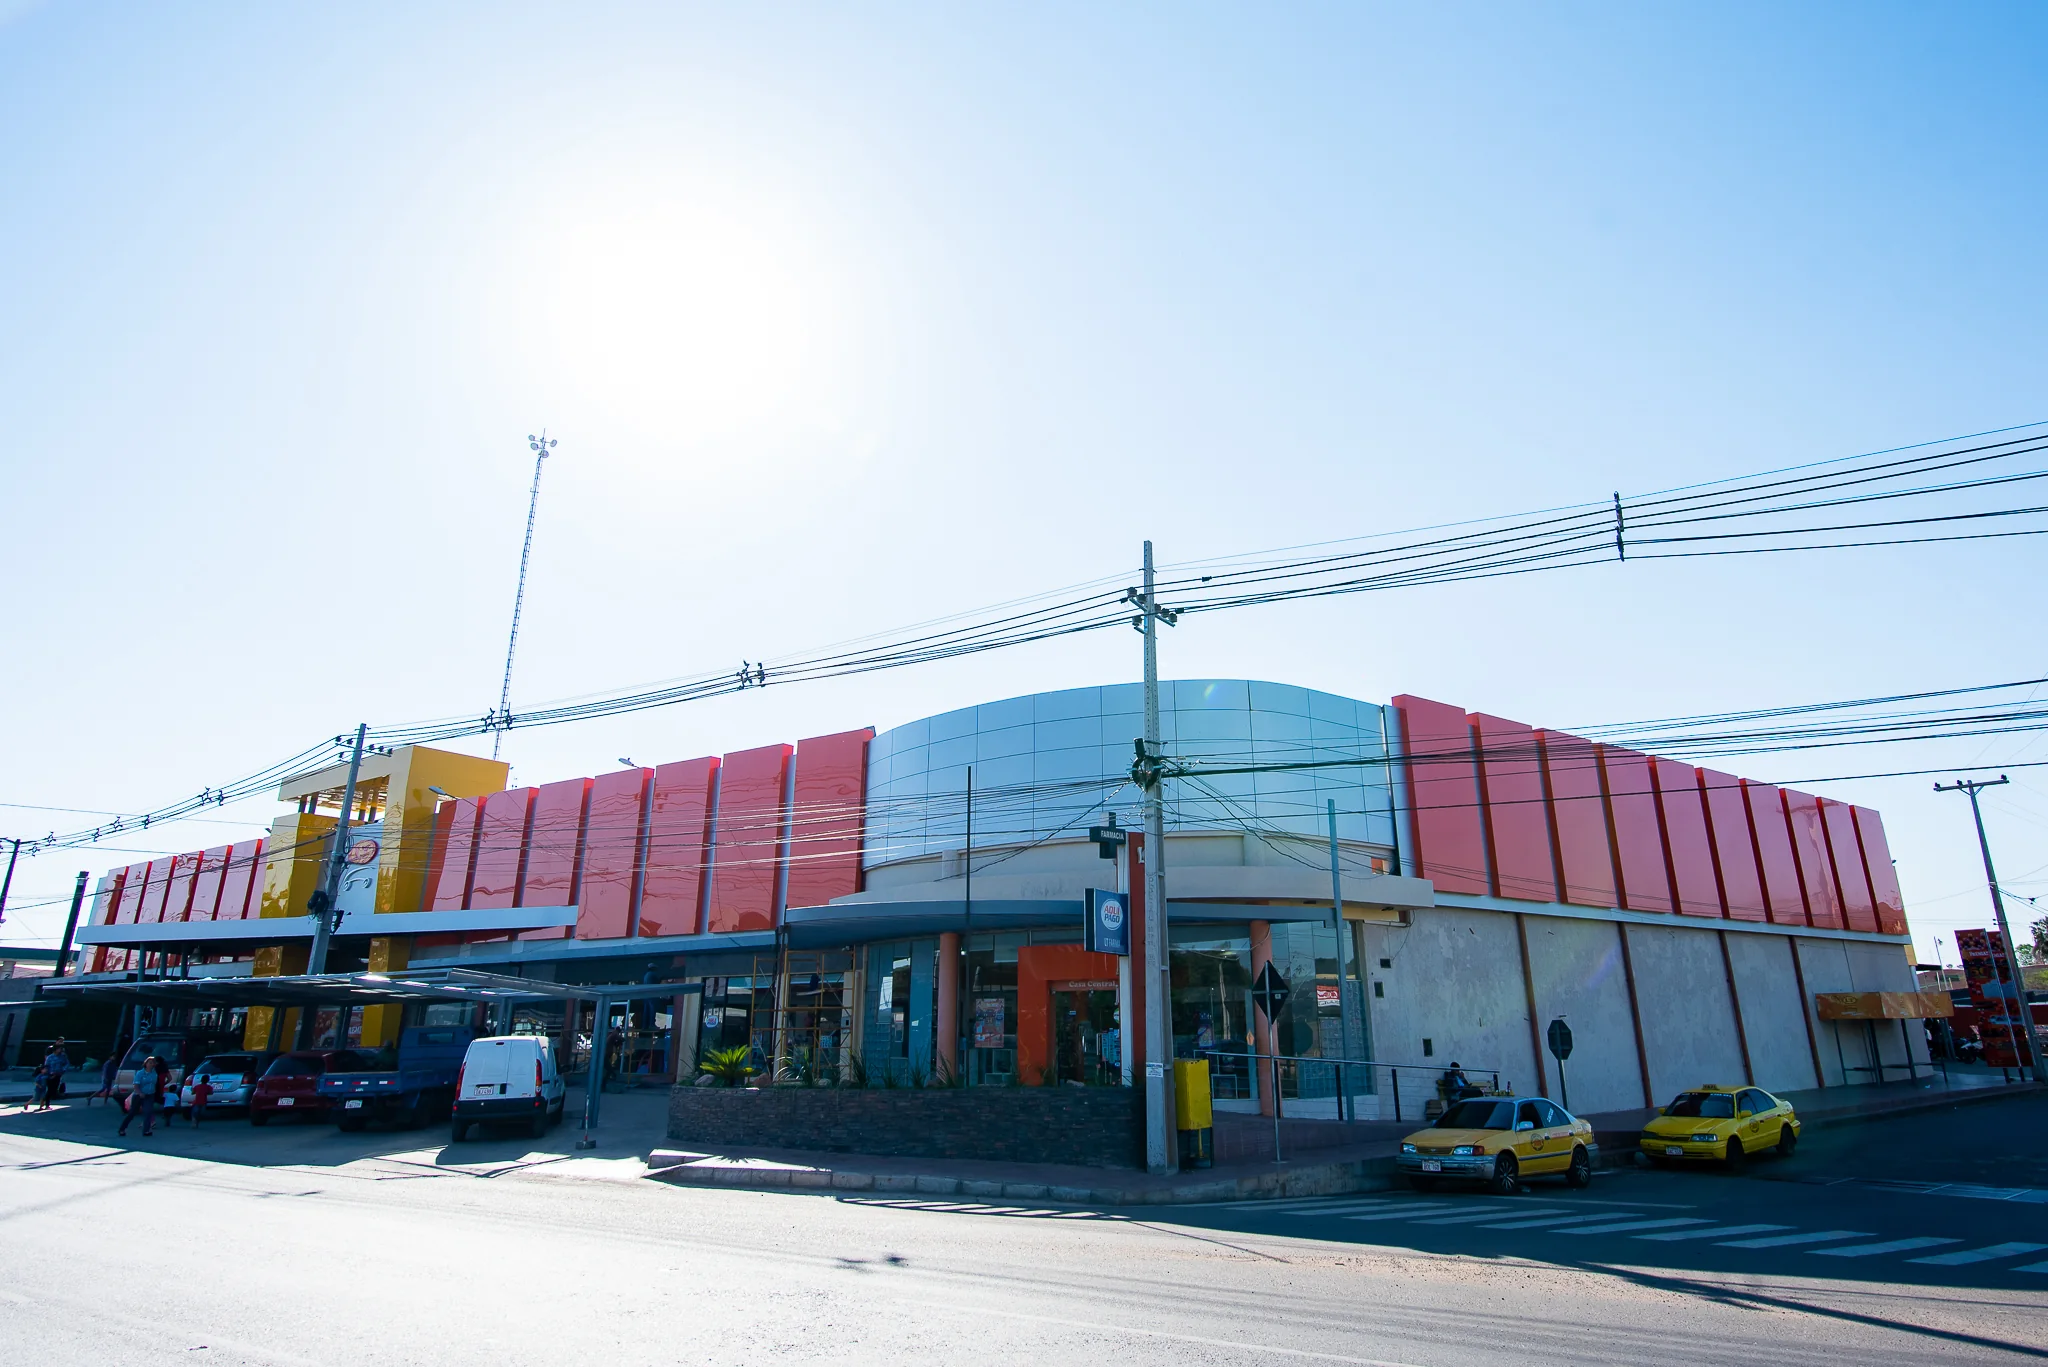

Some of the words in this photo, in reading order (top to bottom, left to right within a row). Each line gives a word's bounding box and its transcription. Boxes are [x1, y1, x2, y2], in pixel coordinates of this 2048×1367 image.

[1101, 830, 1124, 840] FARMACIA
[1104, 914, 1120, 923] PAGO
[1087, 980, 1117, 988] Central
